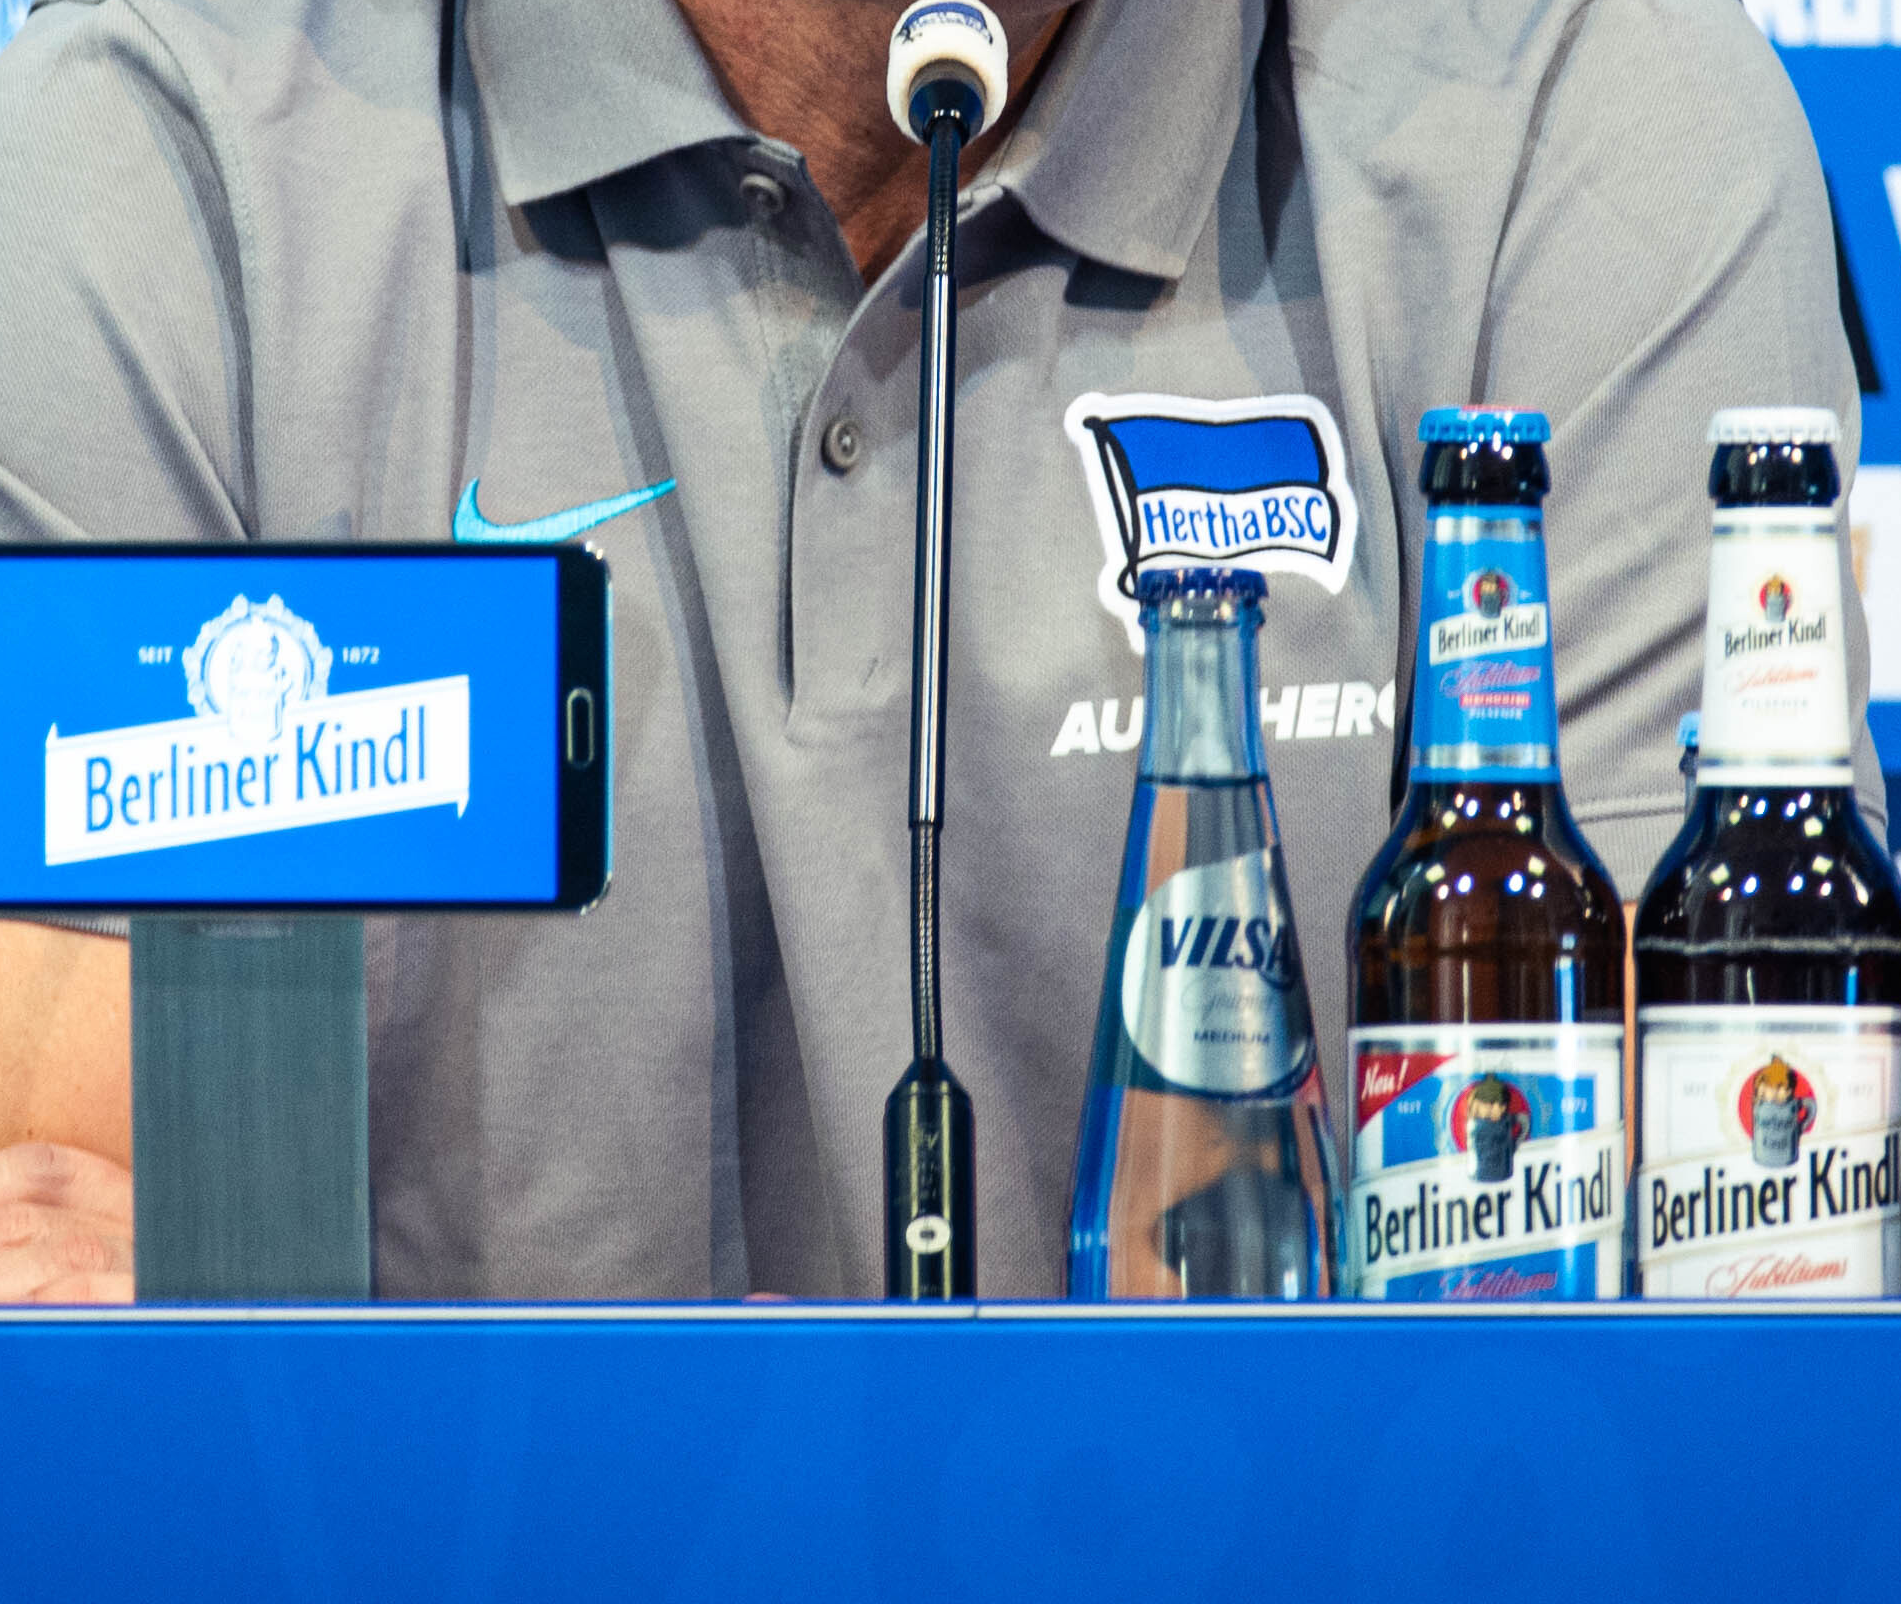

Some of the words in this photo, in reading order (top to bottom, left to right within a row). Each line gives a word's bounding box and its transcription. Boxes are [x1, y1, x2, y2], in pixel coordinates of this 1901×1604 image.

[138, 646, 174, 664] SEIT
[1436, 617, 1499, 656] Berliner
[1724, 625, 1783, 659] Berliner
[1788, 613, 1827, 644] Kindl
[84, 739, 280, 835] Berliner
[295, 704, 427, 799] Kindl
[1361, 1058, 1410, 1102] Neu!
[1365, 1182, 1514, 1266] Berliner
[1523, 1147, 1612, 1235] Kindl
[1651, 1165, 1798, 1250] Berliner
[1809, 1131, 1900, 1221] Kindl
